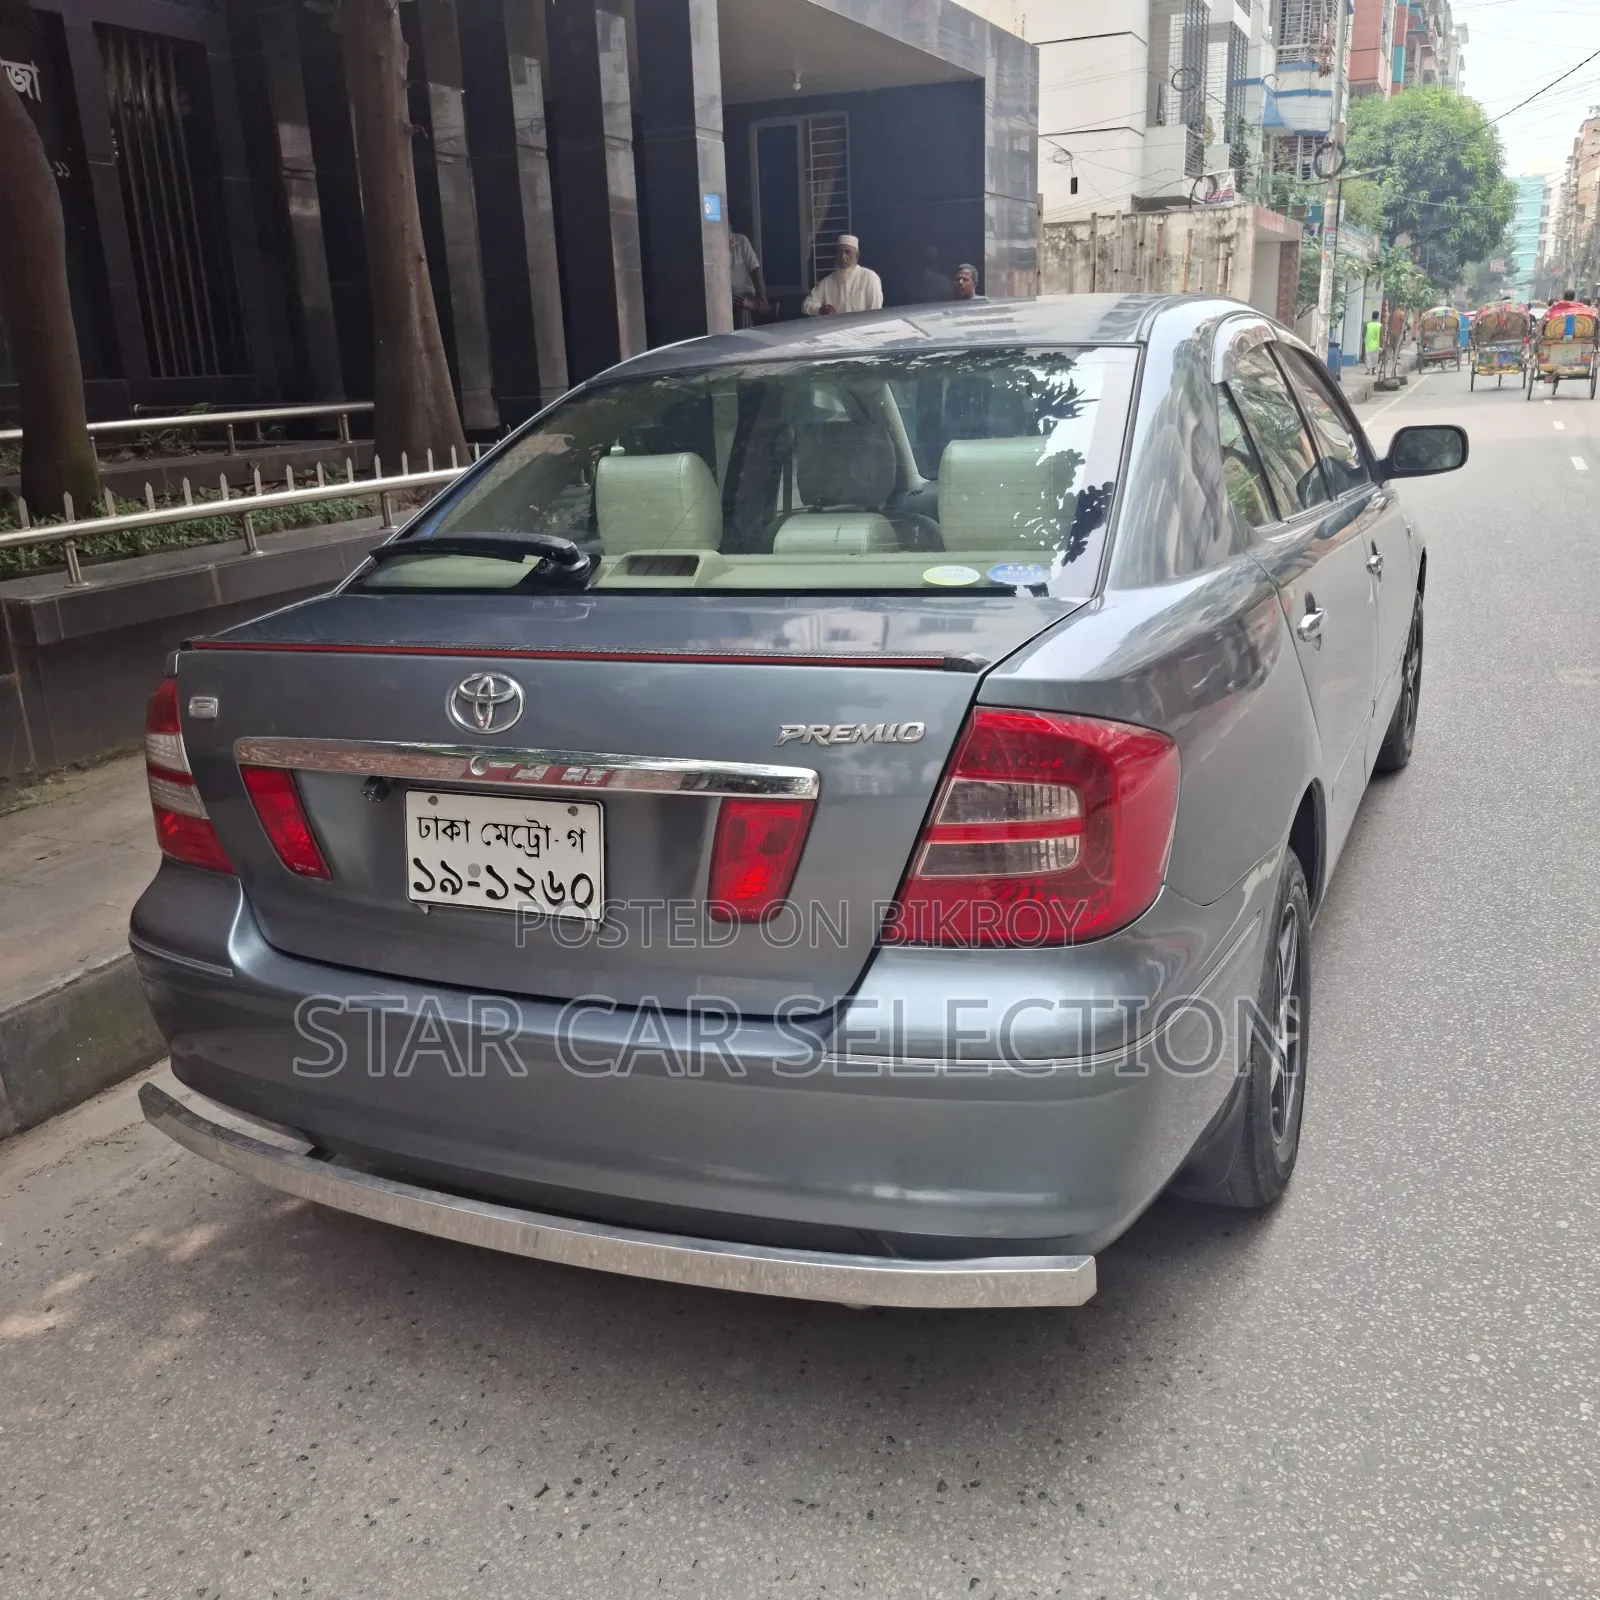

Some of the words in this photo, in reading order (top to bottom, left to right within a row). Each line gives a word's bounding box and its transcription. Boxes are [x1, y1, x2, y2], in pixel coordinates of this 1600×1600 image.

[0, 57, 42, 103] জা
[773, 722, 926, 746] PREMIO
[417, 817, 471, 843] ঢাকা
[413, 857, 594, 910] ১৯-১২৬০
